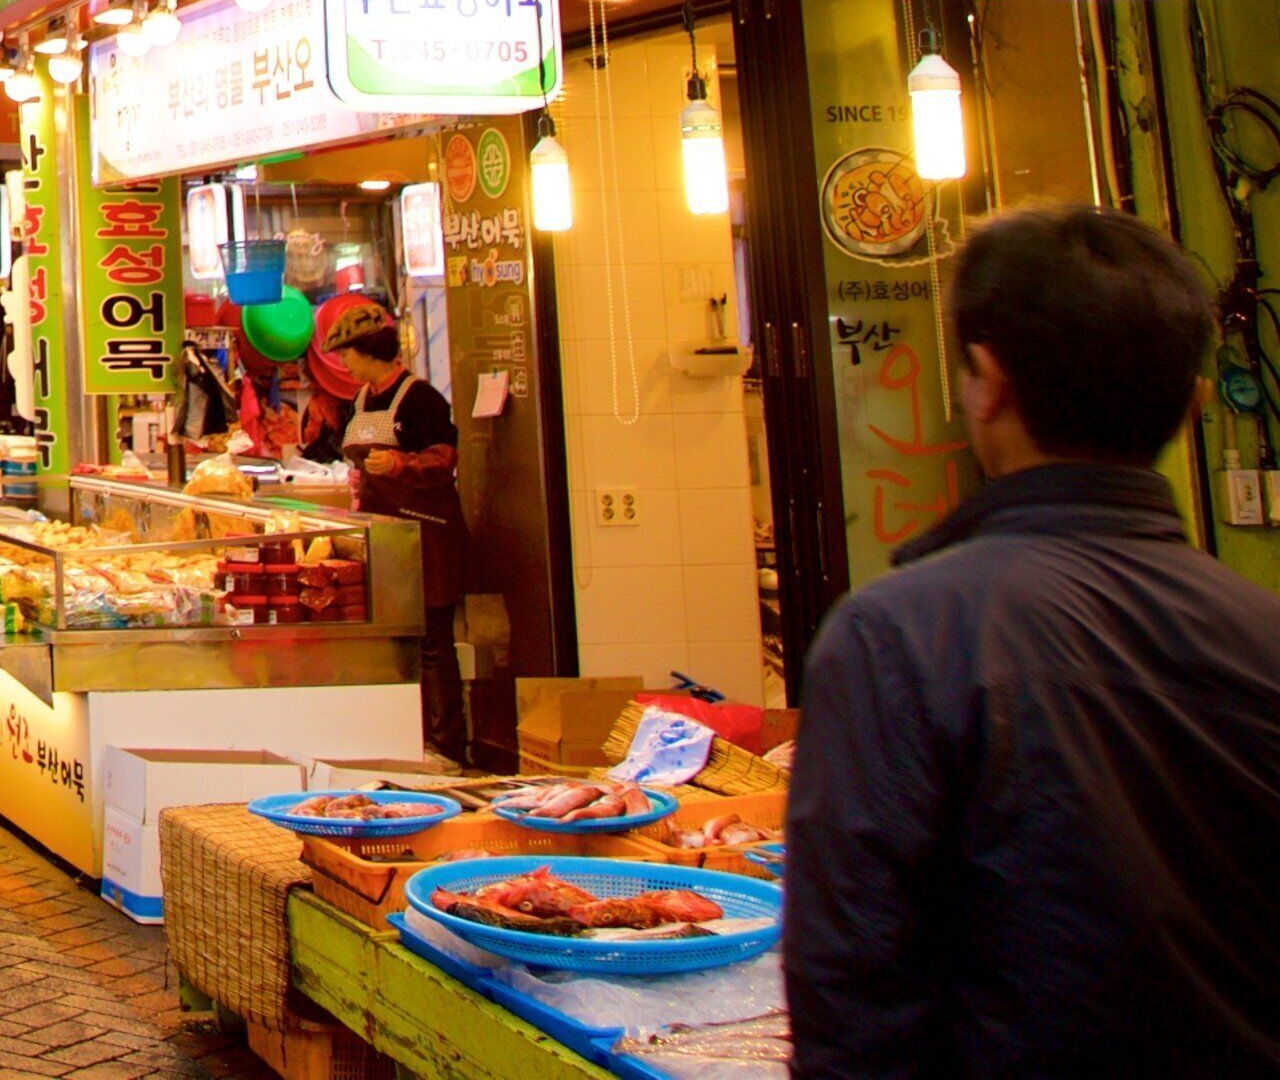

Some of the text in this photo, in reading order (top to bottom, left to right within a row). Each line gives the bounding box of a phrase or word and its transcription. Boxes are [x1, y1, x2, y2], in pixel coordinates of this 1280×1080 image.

[371, 39, 529, 63] T.245-0705
[826, 103, 883, 123] SINCE
[444, 207, 524, 251] 부산어묵
[836, 317, 901, 366] 부산
[37, 738, 85, 804] 부산어묵
